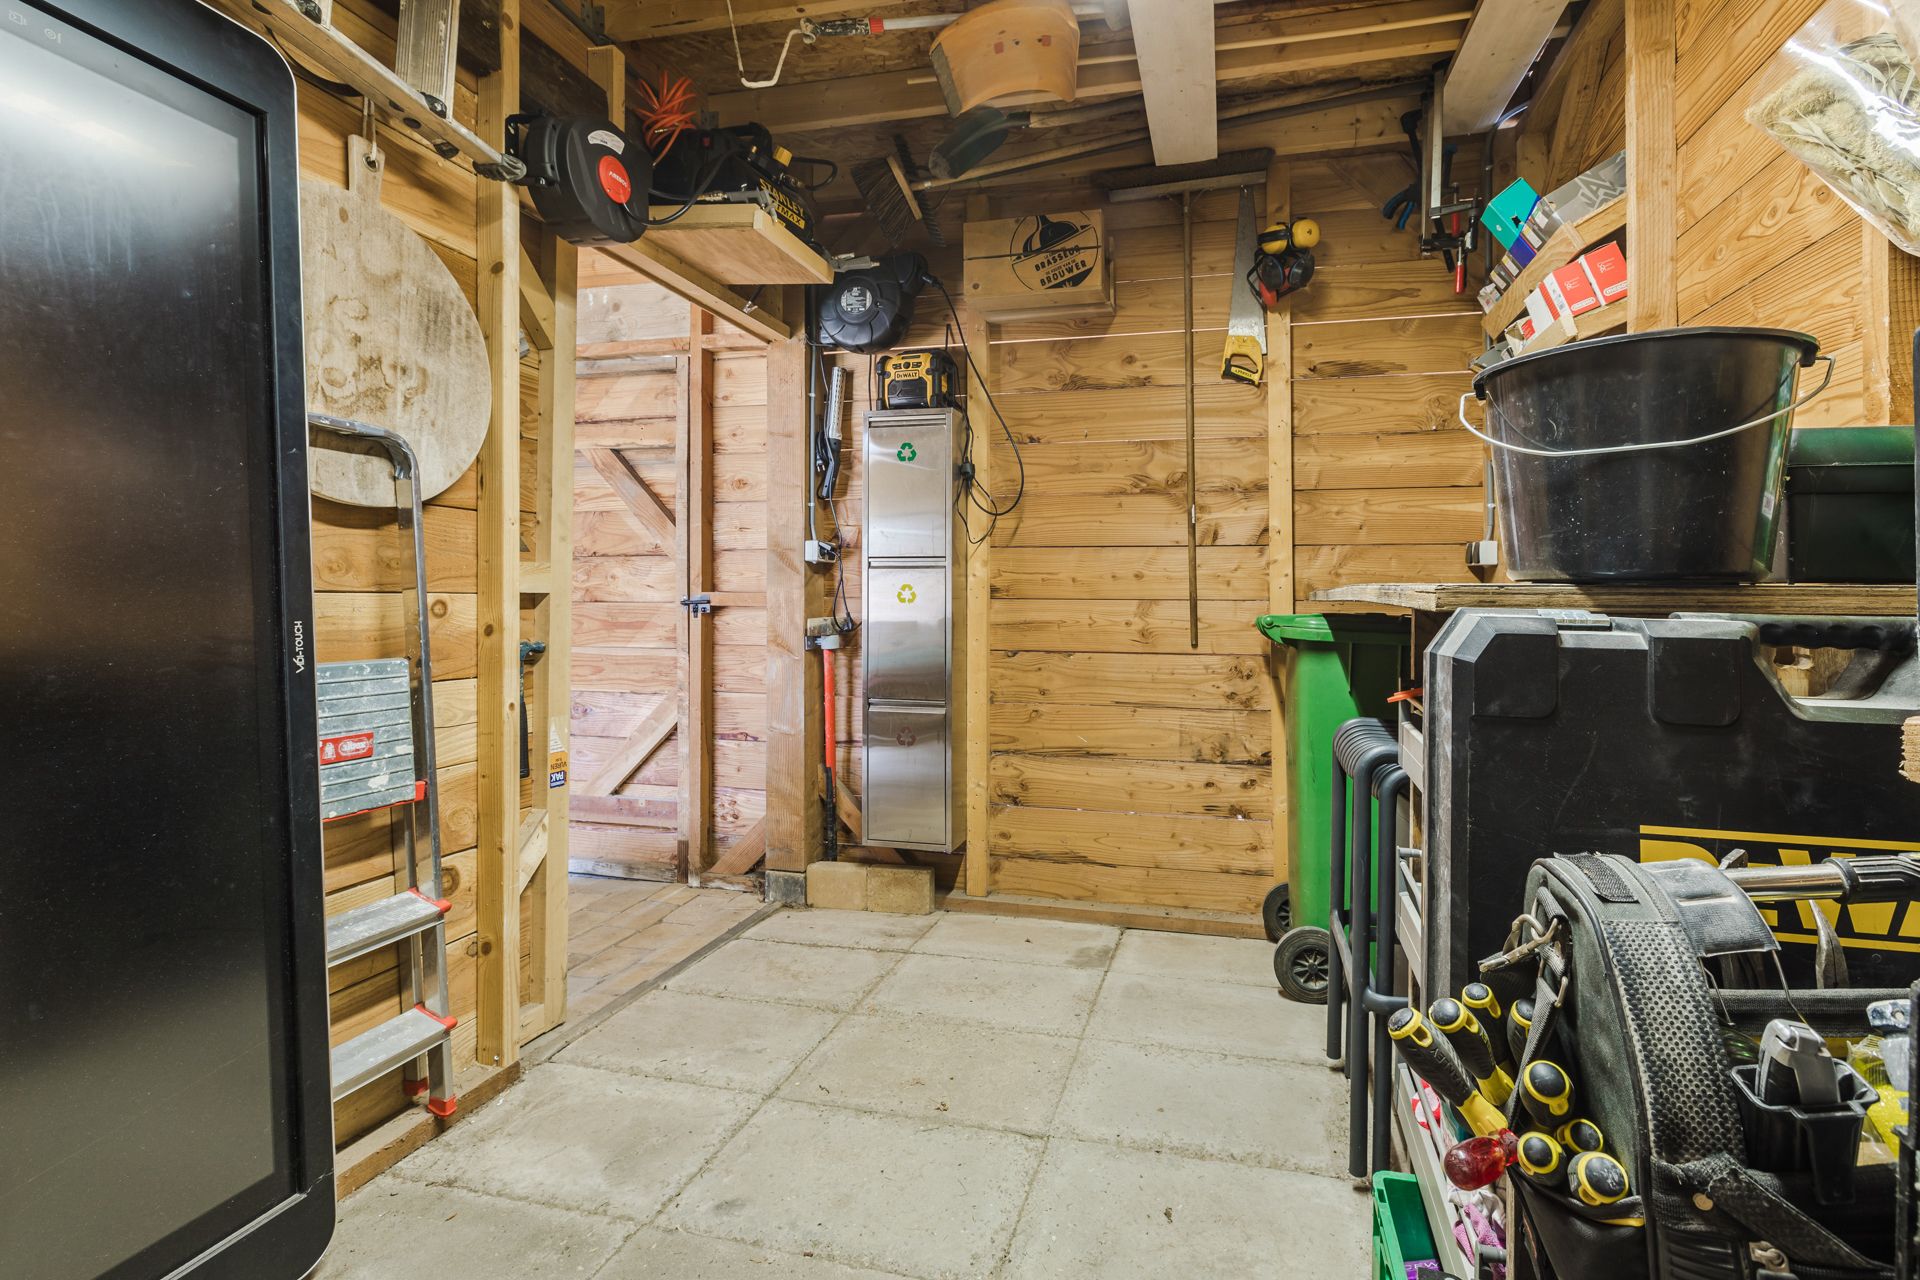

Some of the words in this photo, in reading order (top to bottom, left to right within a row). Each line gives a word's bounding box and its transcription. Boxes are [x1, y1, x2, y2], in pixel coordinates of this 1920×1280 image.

[760, 178, 804, 218] STANLEY
[1035, 244, 1080, 272] BRASSEUR
[1040, 259, 1087, 287] BROUWER
[550, 770, 564, 783] PAK
